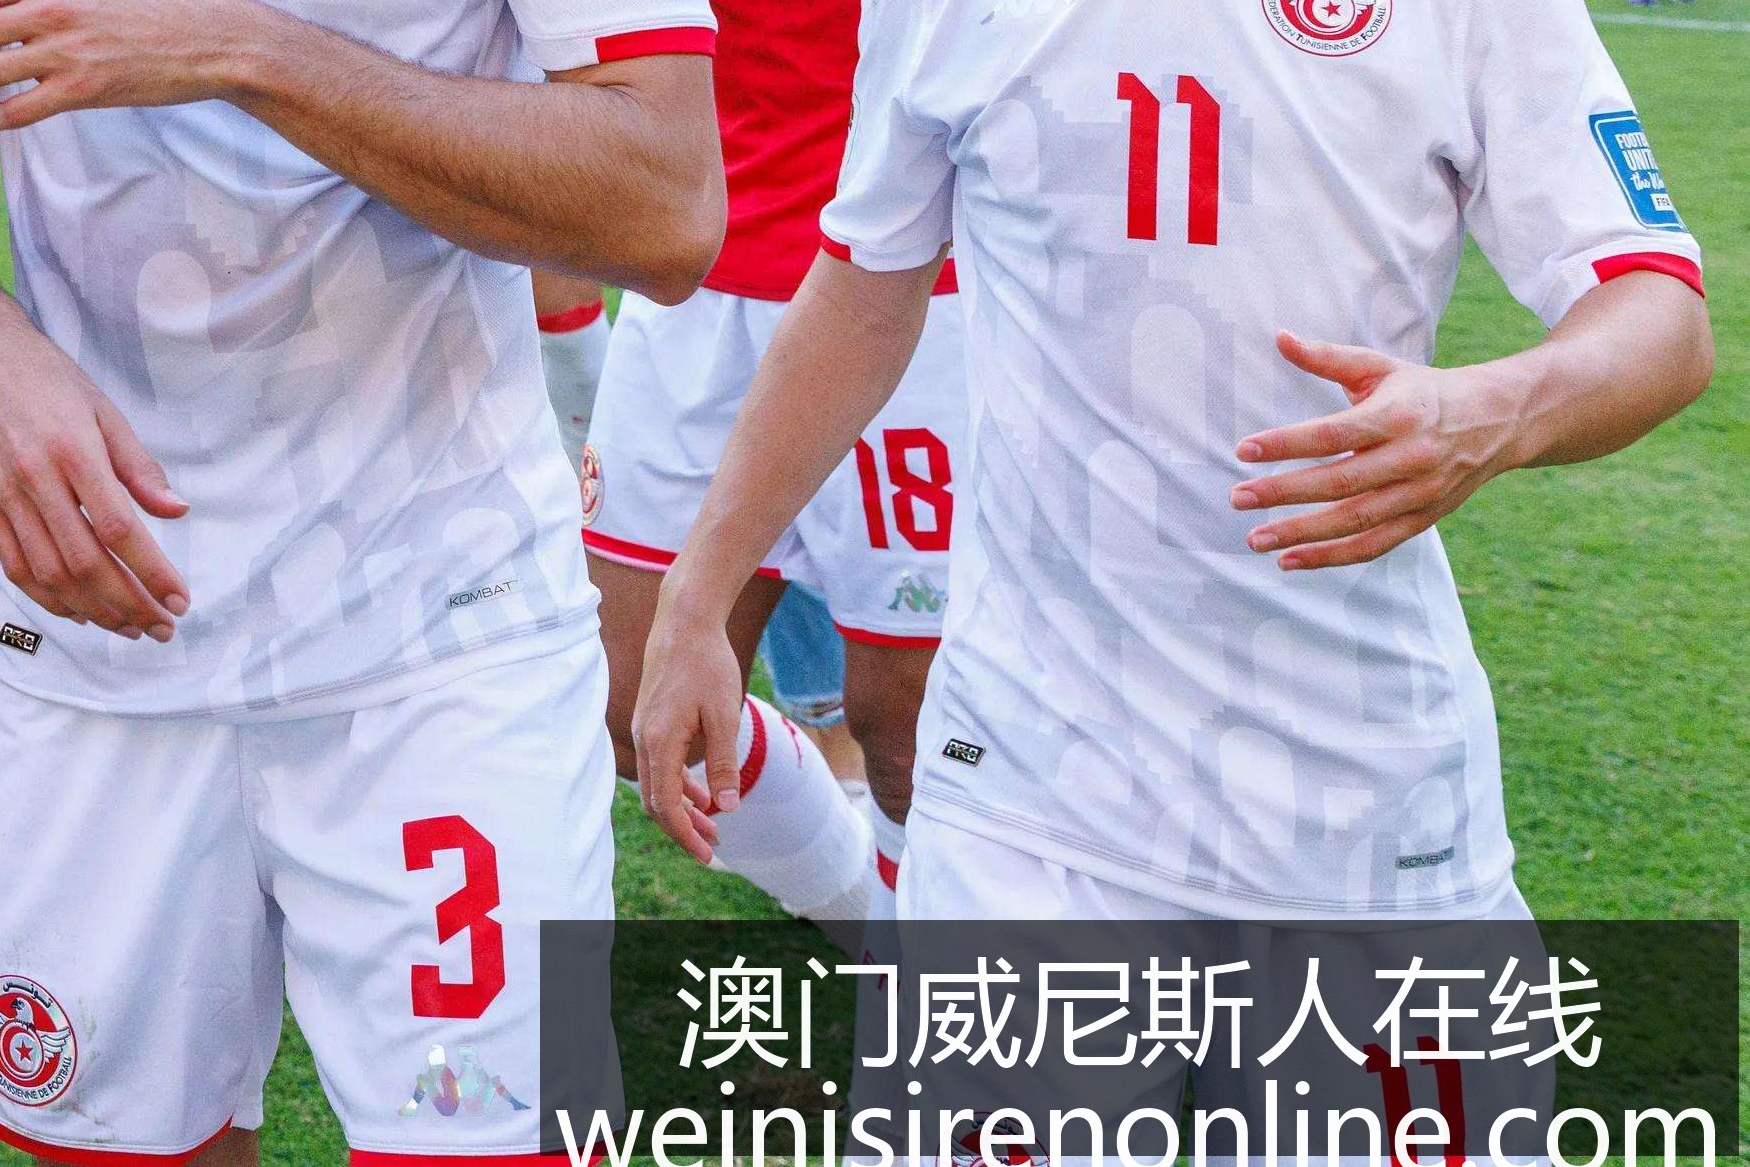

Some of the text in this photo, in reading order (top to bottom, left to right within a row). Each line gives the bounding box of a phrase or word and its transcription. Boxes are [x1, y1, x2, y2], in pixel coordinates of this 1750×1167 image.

[1295, 34, 1349, 51] TUNISIENNE
[1350, 35, 1362, 47] DE
[1360, 7, 1387, 41] FOOTBALL
[1117, 72, 1220, 246] 11
[853, 428, 953, 551] 18
[402, 815, 505, 1019] 3
[3, 981, 53, 1009] تونس
[38, 1087, 50, 1099] DE
[49, 1057, 72, 1093] FOOTBALL
